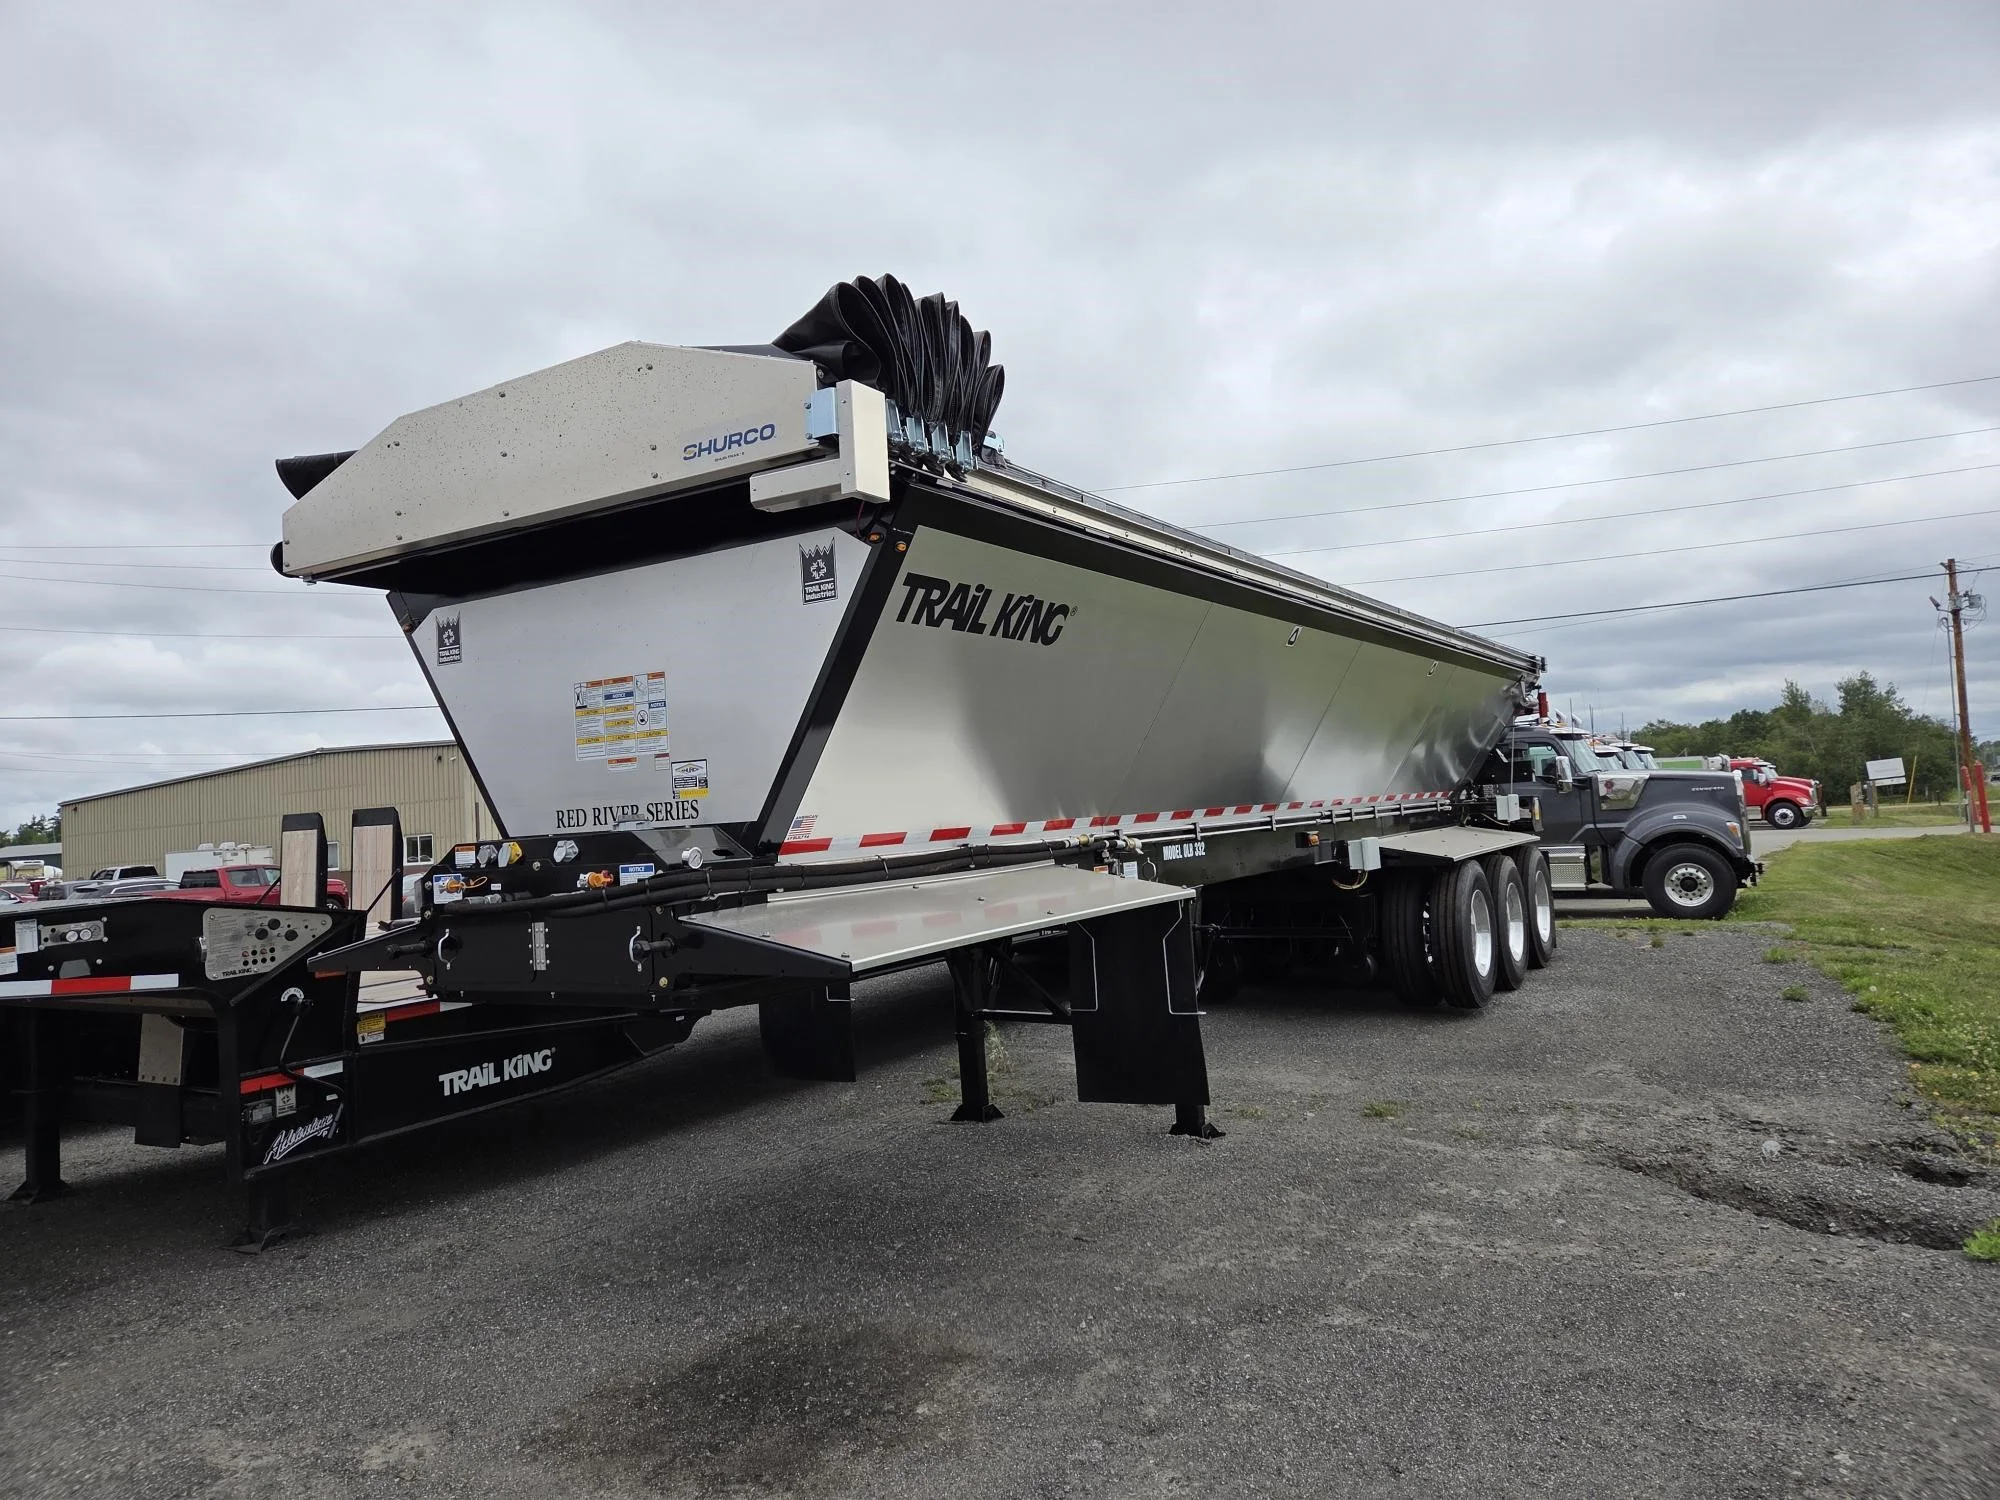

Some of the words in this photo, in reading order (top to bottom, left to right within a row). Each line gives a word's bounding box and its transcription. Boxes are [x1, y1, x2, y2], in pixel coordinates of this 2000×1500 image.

[683, 423, 775, 461] SHURCO
[556, 808, 587, 828] RED
[647, 799, 699, 822] SERIES
[1163, 844, 1183, 860] MODEL
[1194, 841, 1206, 857] 332
